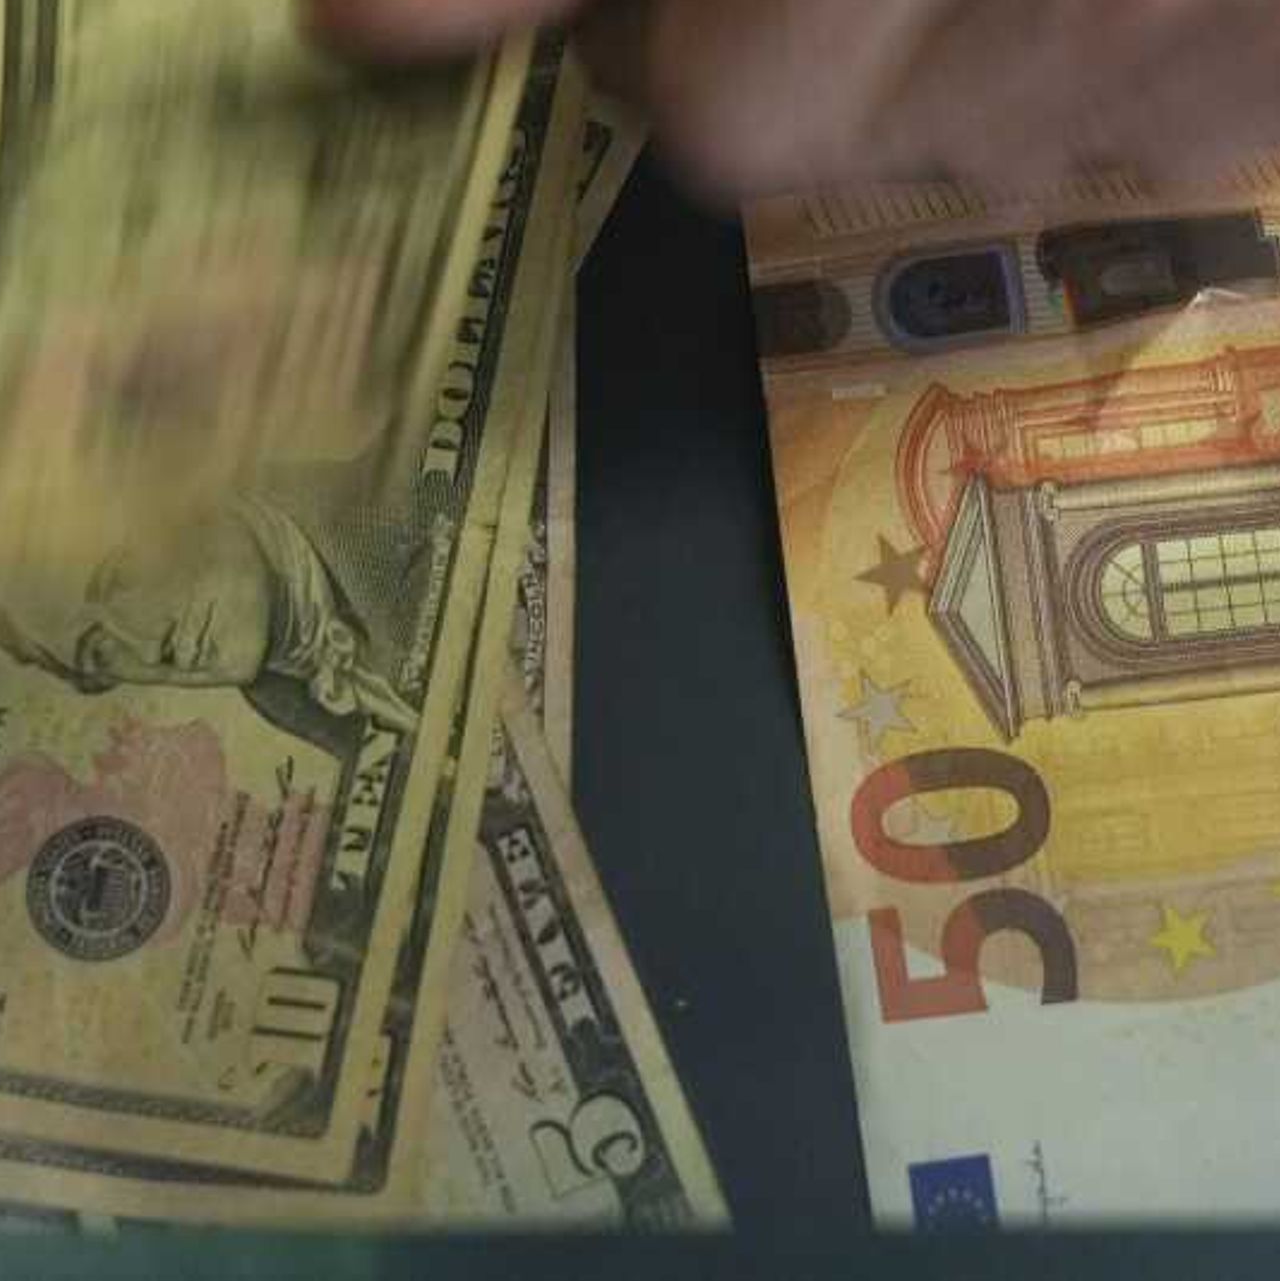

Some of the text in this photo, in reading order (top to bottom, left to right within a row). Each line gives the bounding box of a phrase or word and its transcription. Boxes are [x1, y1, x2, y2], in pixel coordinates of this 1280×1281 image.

[328, 722, 402, 892] TEN
[851, 747, 1079, 1024] 50
[499, 827, 599, 1029] FIVE
[250, 965, 342, 1075] 10
[531, 1092, 645, 1200] 5
